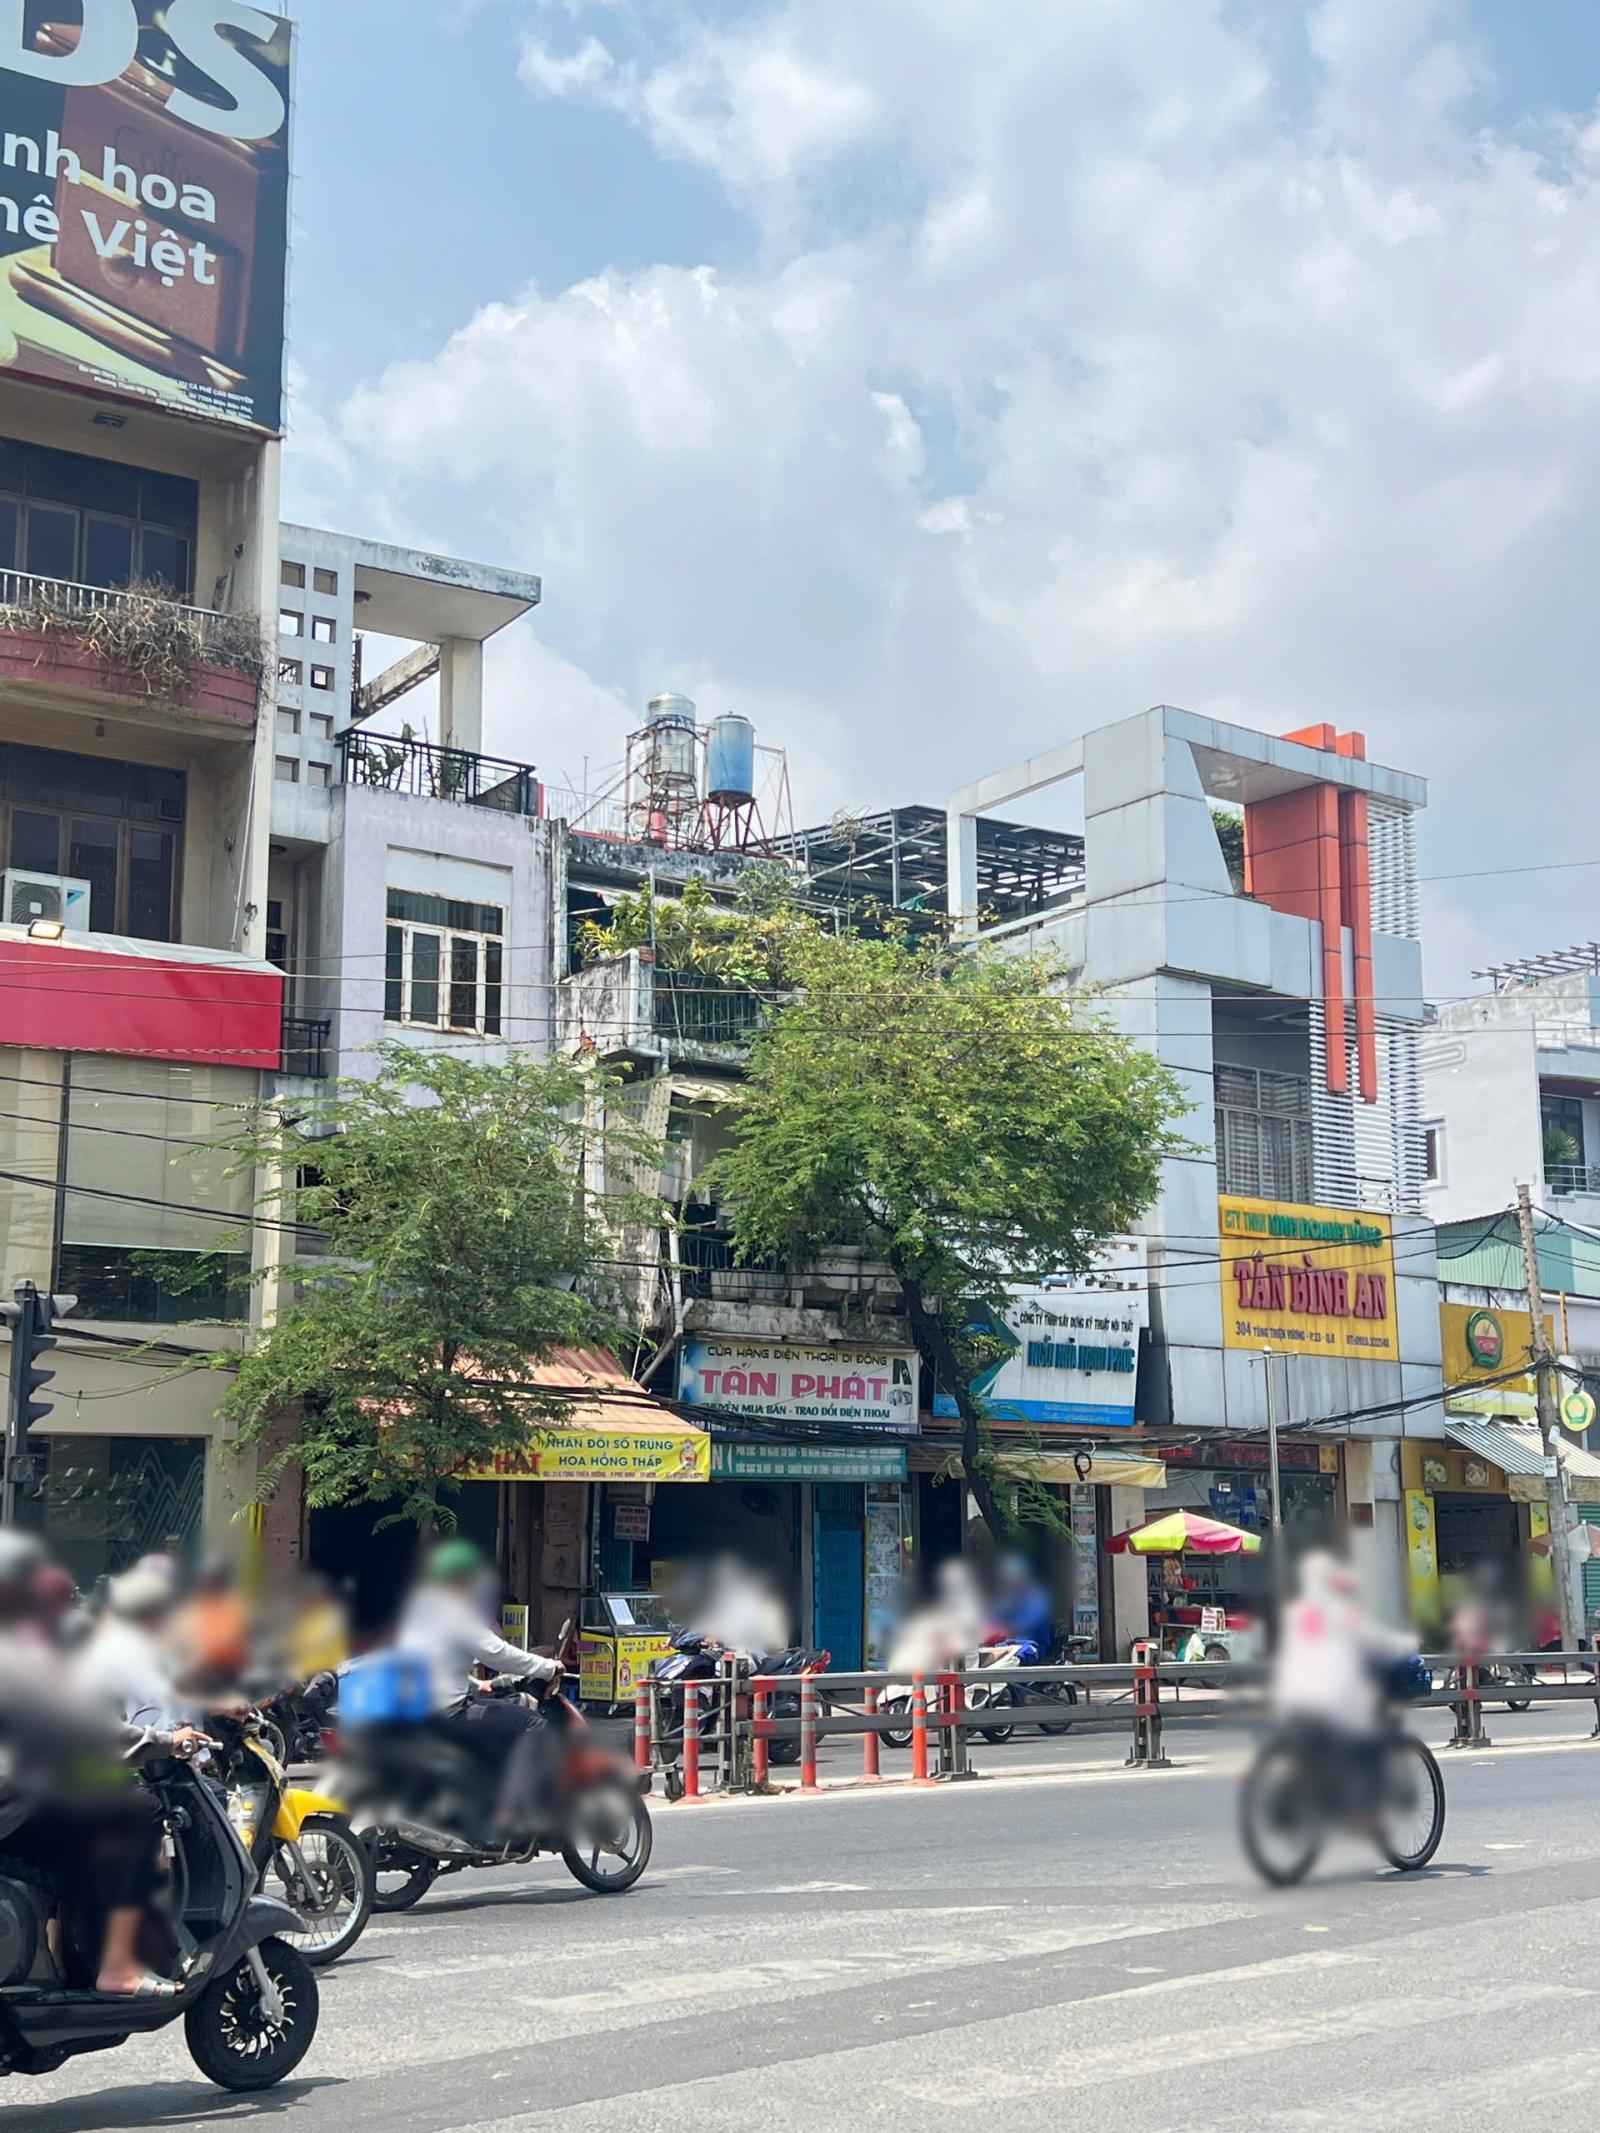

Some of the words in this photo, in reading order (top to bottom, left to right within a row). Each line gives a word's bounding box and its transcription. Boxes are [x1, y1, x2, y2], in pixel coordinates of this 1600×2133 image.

[102, 146, 216, 223] hoa
[80, 209, 216, 287] Việt
[1233, 1249, 1285, 1310] TÂN
[1288, 1253, 1349, 1317] BÌNH
[1353, 1273, 1387, 1319] AN
[1020, 1310, 1035, 1325] CÔNG
[1235, 1320, 1251, 1336] 304
[707, 1344, 733, 1357] CỬA
[737, 1345, 770, 1359] HÀNG
[773, 1347, 799, 1363] ĐIỆN
[804, 1351, 839, 1366] THOẠI
[842, 1353, 852, 1364] DI
[856, 1352, 888, 1367] ĐỘNG
[698, 1362, 778, 1397] TẤN
[791, 1371, 889, 1401] PHÁT
[741, 1404, 764, 1414] MUA
[795, 1406, 819, 1416] TRAO
[864, 1408, 890, 1420] THOẠI
[613, 1436, 630, 1449] SỐ
[559, 1455, 586, 1466] HOA
[590, 1452, 628, 1466] HỒNG
[631, 1453, 662, 1467] THẤP
